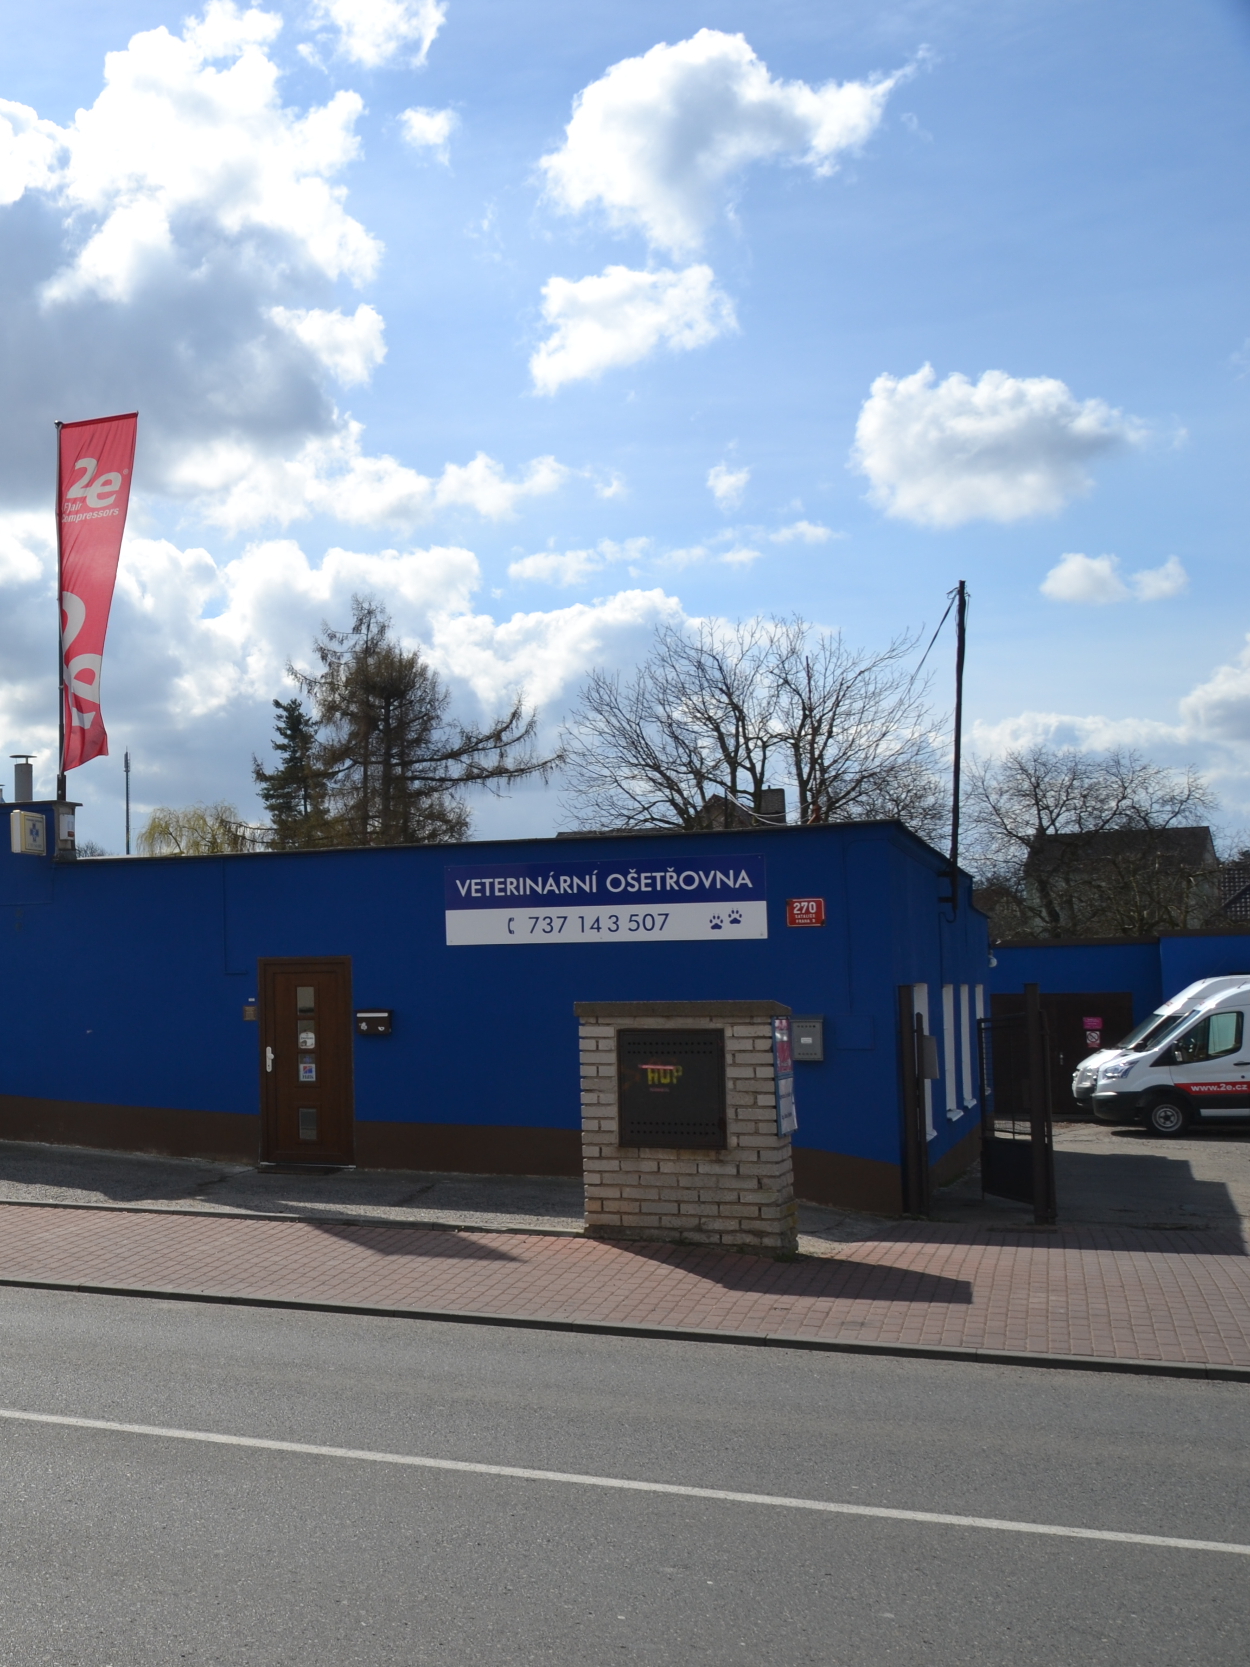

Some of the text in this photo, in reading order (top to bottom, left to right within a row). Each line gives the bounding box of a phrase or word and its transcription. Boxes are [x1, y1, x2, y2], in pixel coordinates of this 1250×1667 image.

[66, 457, 123, 508] 2e
[455, 866, 753, 898] VETERINÁRNÍ OŠETŘOVNA
[793, 902, 817, 914] 270
[527, 912, 670, 934] 737 143 507
[1190, 1083, 1248, 1092] www.2e.cz
